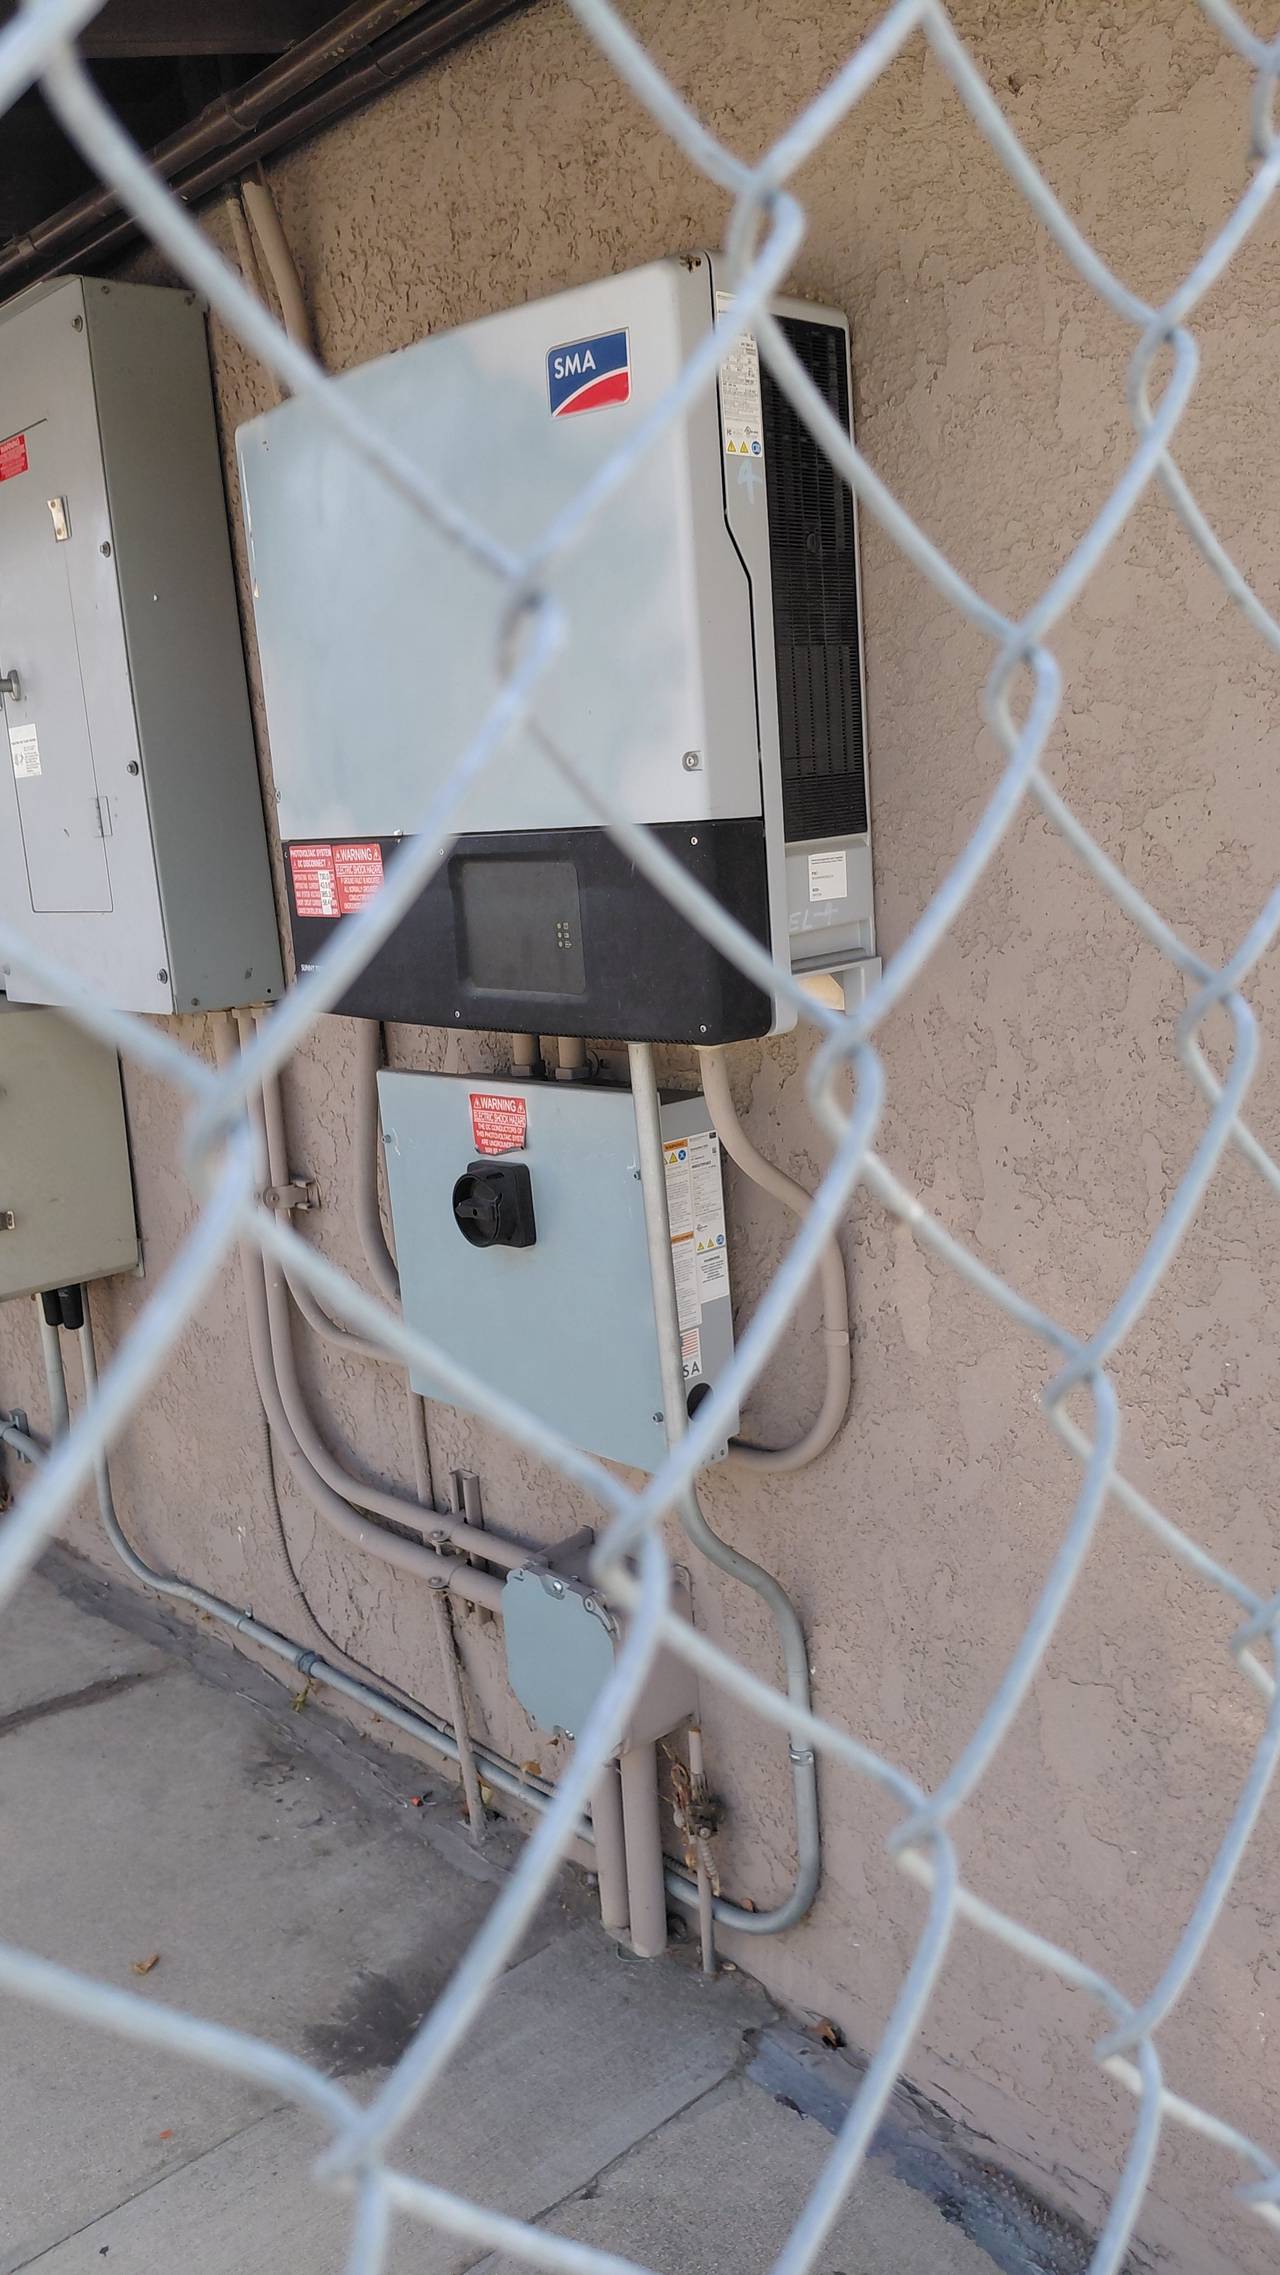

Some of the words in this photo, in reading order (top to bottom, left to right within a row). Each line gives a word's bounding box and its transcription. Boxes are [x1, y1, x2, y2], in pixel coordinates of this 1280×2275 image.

[554, 349, 597, 380] SMA
[341, 848, 373, 861] WARNING
[480, 1097, 516, 1112] WARNING
[682, 1361, 700, 1378] SA
